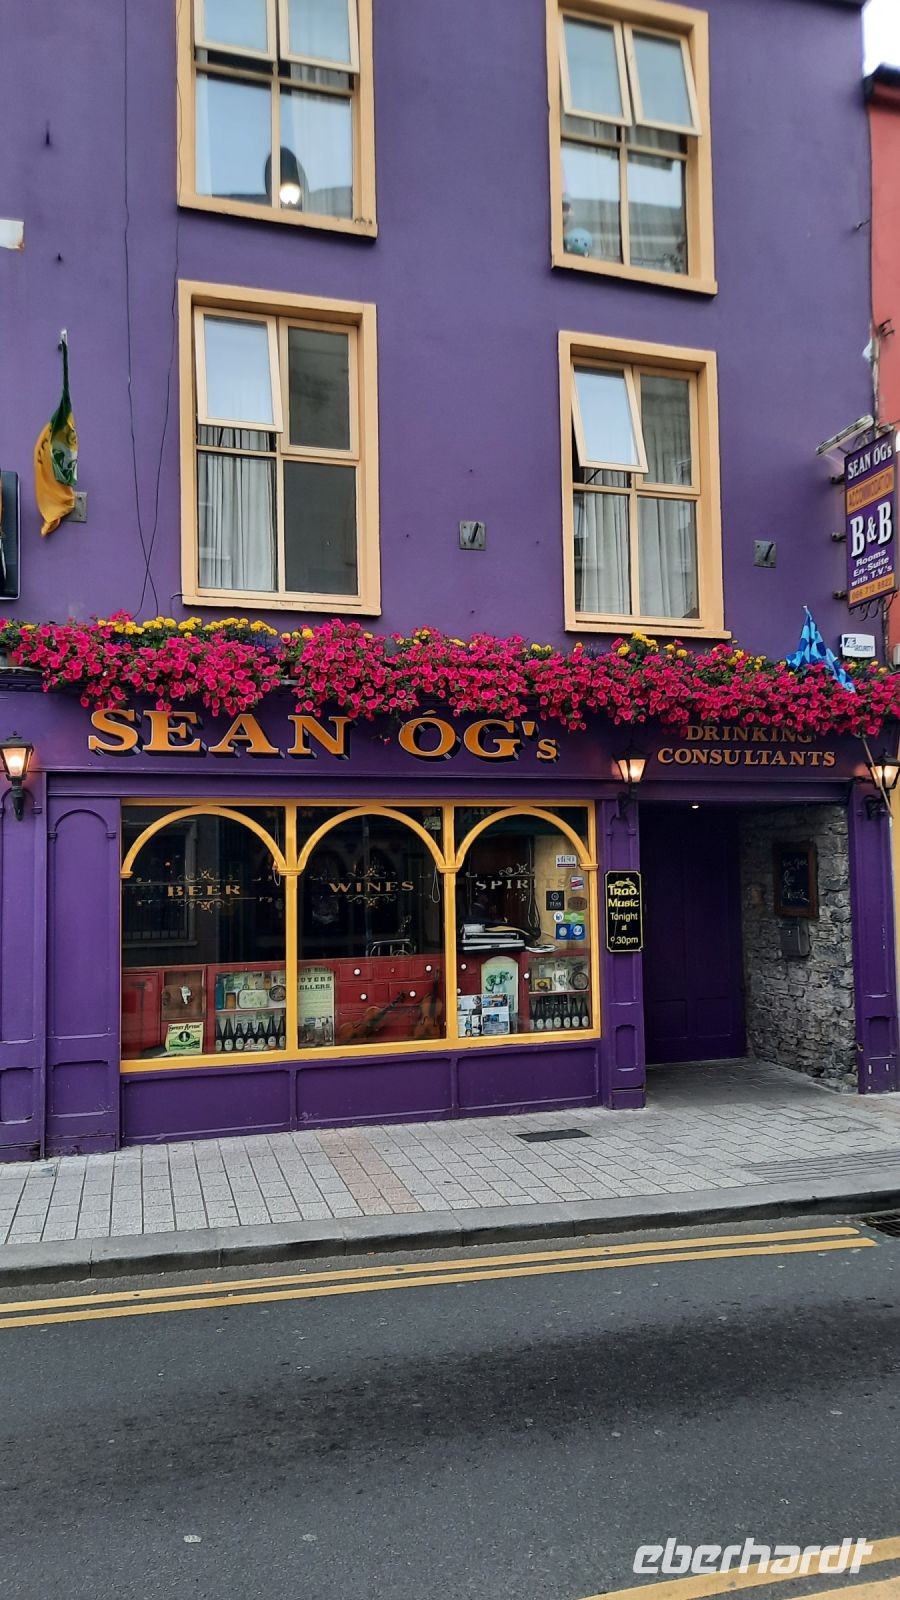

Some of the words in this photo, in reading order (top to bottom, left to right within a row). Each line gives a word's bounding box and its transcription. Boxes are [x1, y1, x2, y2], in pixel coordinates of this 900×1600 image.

[847, 452, 871, 480] SEAN
[850, 501, 893, 557] B&B
[853, 557, 890, 577] En-Suite
[856, 549, 887, 567] Rooms
[851, 576, 868, 586] with
[88, 709, 352, 757] SEAN
[657, 748, 836, 767] CONSULTANTS
[166, 884, 241, 897] BEER
[328, 881, 415, 893] WINES
[608, 897, 639, 908] Music
[610, 912, 638, 922] Tonight
